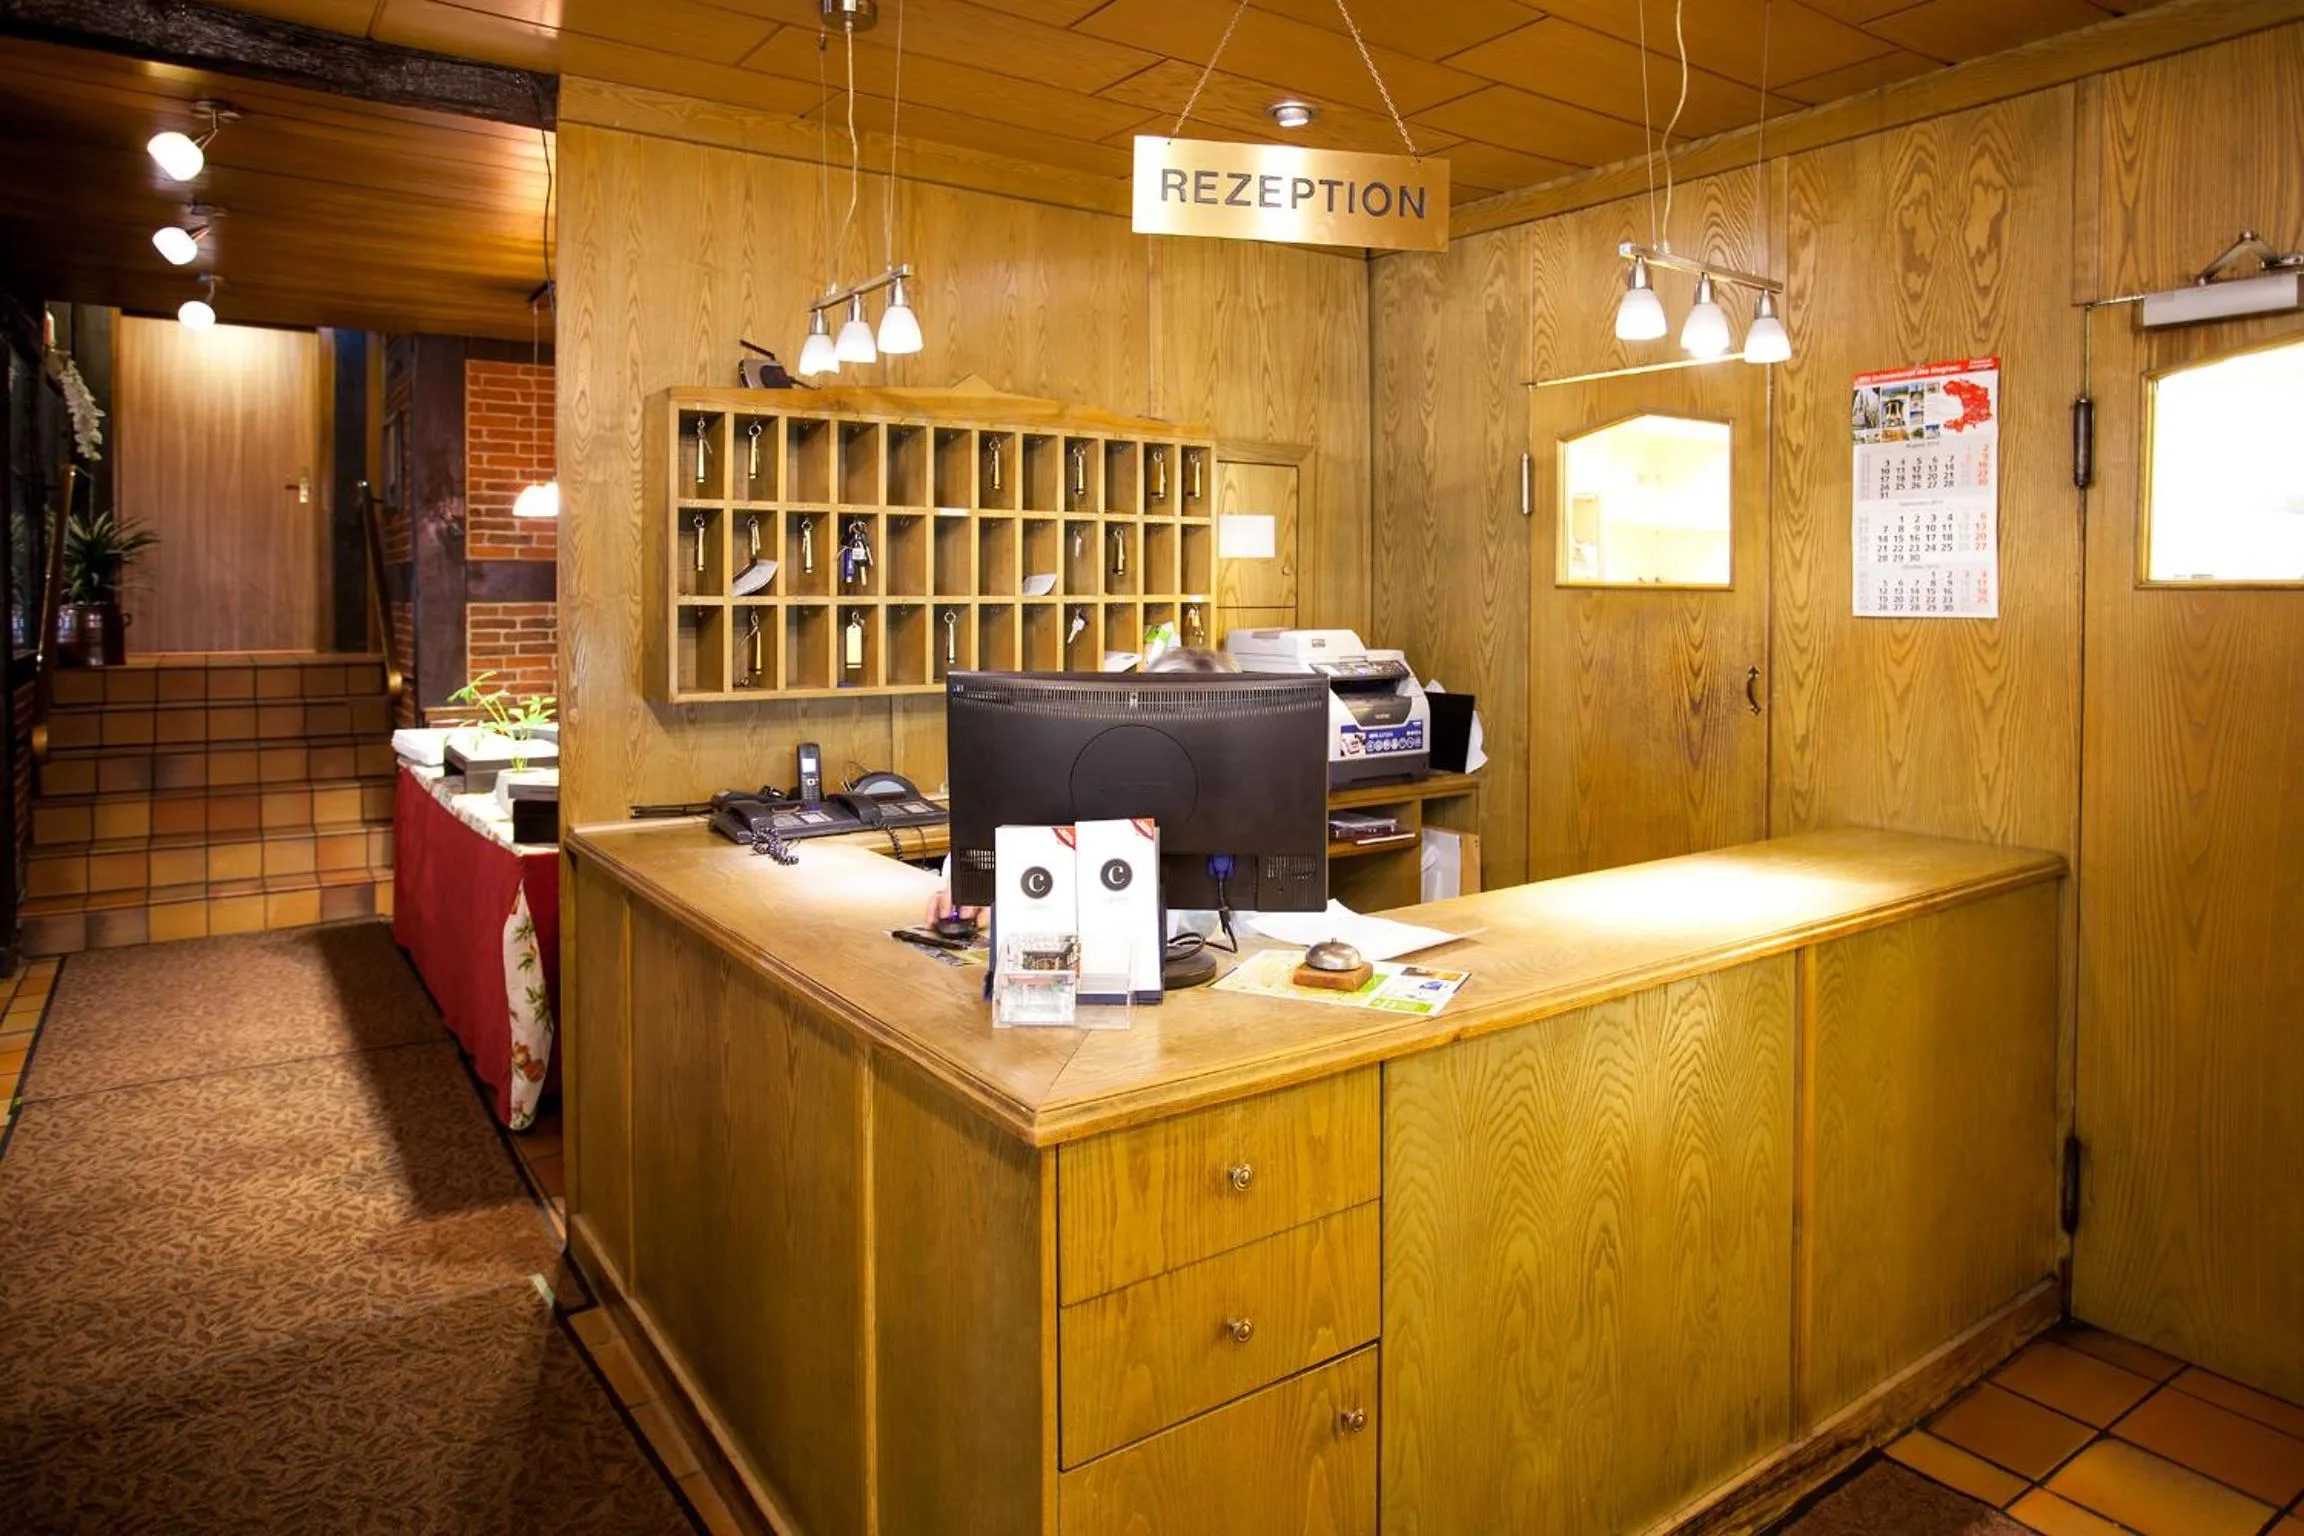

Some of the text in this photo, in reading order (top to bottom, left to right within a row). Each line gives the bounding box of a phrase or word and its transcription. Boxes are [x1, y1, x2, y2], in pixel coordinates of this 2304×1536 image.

[1160, 168, 1425, 219] REZEPTION
[1028, 873, 1045, 892] C
[1108, 866, 1124, 884] C
